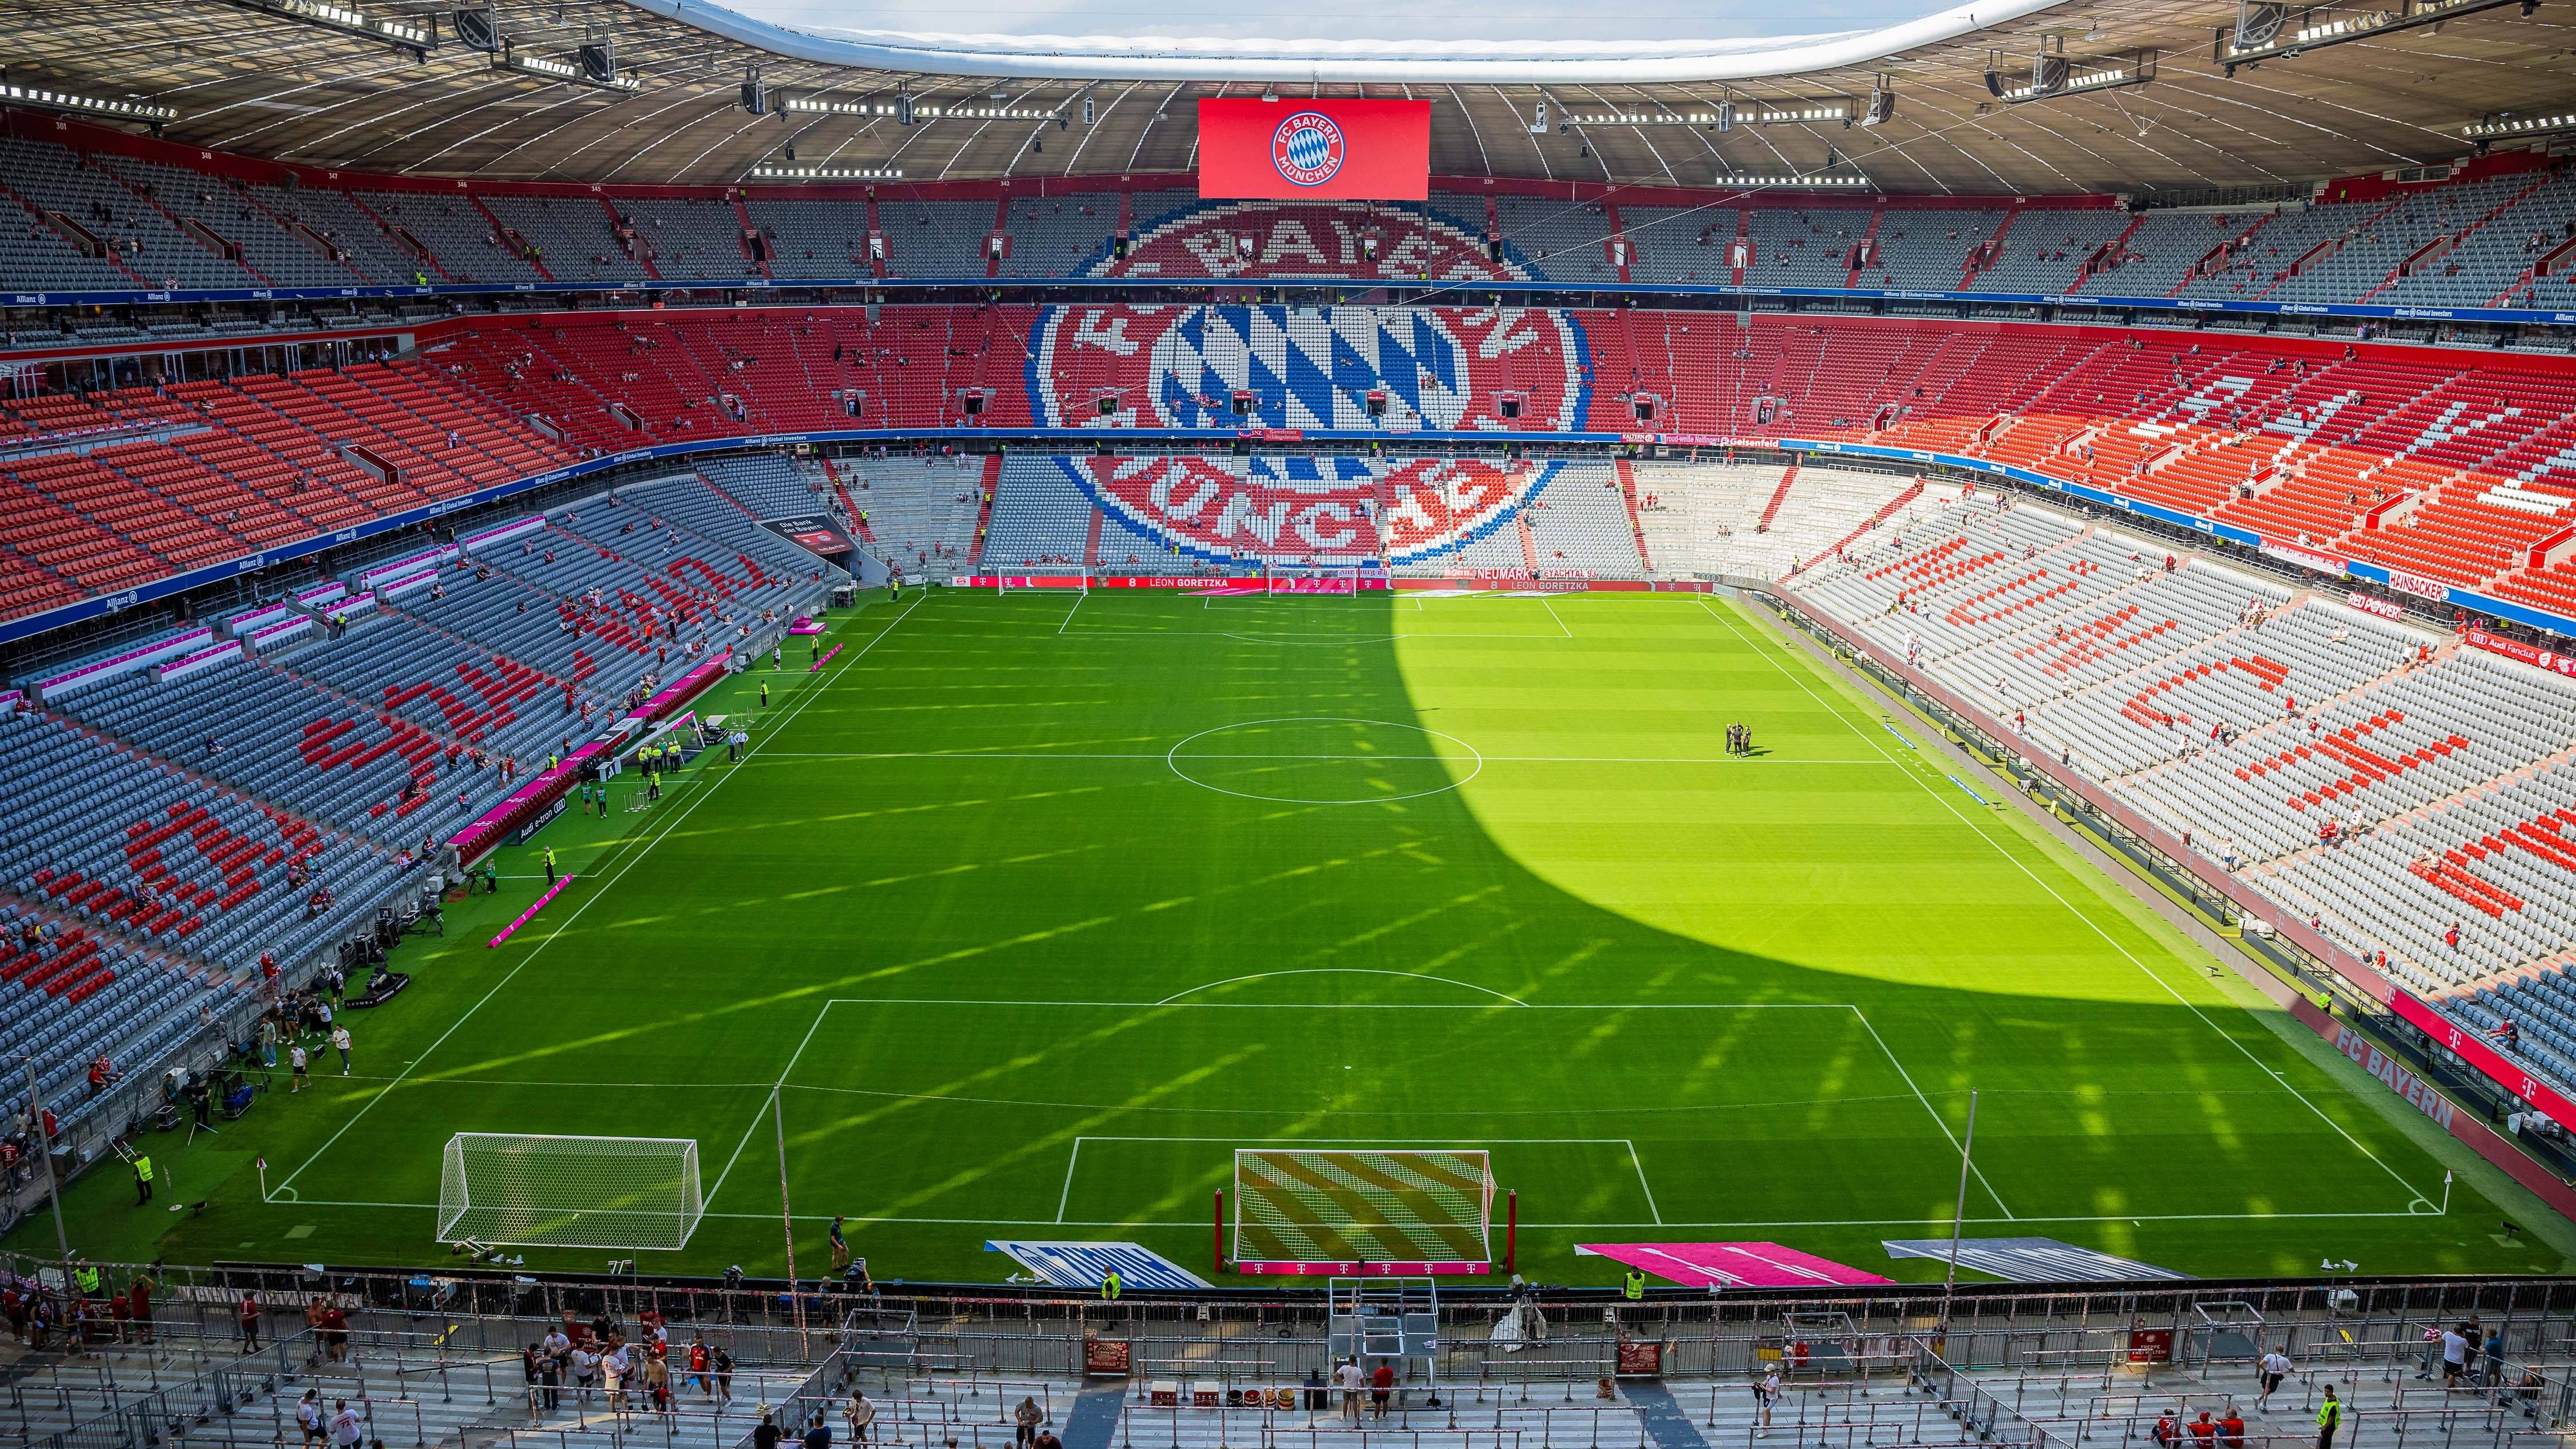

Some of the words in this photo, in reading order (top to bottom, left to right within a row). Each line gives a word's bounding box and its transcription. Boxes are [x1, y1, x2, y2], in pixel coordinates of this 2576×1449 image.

[56, 121, 67, 131] 301
[1277, 126, 1292, 144] FC
[1292, 116, 1340, 144] BAYERN
[202, 152, 212, 160] 348
[1278, 156, 1338, 181] MÜNCHEN
[17, 295, 36, 303] Allianz
[148, 291, 164, 300] Allianz
[1730, 439, 1779, 448] Geisenfeld
[557, 471, 569, 479] Investors
[429, 506, 442, 515] Allianz
[447, 502, 457, 510] Global
[457, 498, 473, 507] Investors
[796, 524, 823, 532] Bayern
[336, 533, 351, 542] Allianz
[239, 560, 256, 570] Allianz
[1477, 568, 1531, 580] NEUMARK
[1128, 578, 1136, 587] 8
[1149, 578, 1174, 587] LEON
[1177, 578, 1228, 587] GORETZKA
[1491, 581, 1498, 590] 8
[1511, 581, 1535, 589] LEON
[1539, 582, 1589, 590] GORETZKA
[2391, 573, 2442, 599] HAINSACKER
[1714, 585, 1729, 594] Allianz
[107, 596, 129, 609] Allianz
[2349, 592, 2365, 605] RED
[2365, 597, 2400, 618] POWER
[2488, 639, 2506, 652] Audi
[2507, 643, 2536, 659] Fanclub
[521, 823, 534, 839] Audi
[535, 810, 552, 827] e-tron
[2337, 1026, 2363, 1061] FC
[2366, 1047, 2454, 1130] BAYERN
